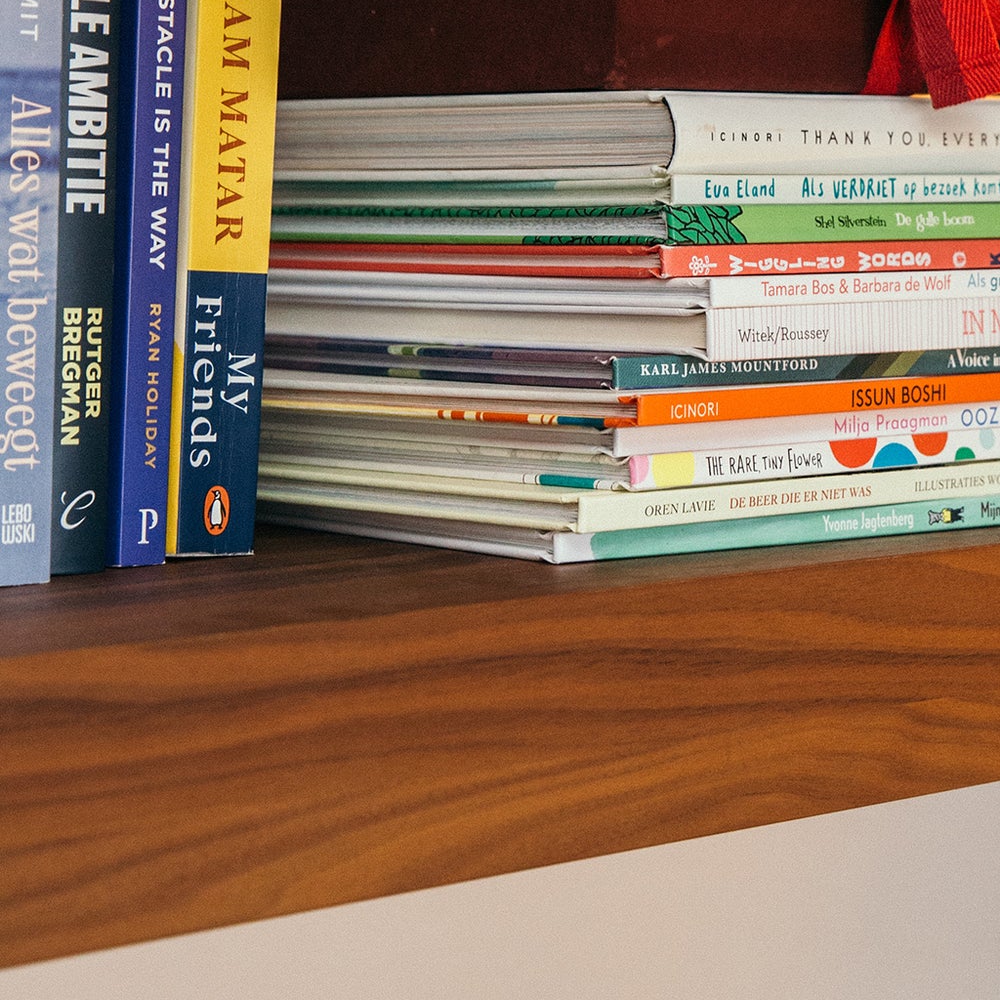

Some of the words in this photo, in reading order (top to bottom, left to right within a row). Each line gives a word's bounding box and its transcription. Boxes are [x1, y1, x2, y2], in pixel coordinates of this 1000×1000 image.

[65, 43, 110, 215] AMBITIE
[153, 107, 171, 133] IS
[710, 131, 782, 143] ICINORI
[800, 129, 872, 146] THANK
[887, 130, 931, 147] YOU.
[9, 93, 53, 194] Alles
[151, 143, 170, 197] THE
[214, 86, 250, 246] MATAR
[704, 179, 730, 199] Eva
[736, 177, 776, 198] Eland
[801, 176, 825, 199] Als
[832, 177, 897, 200] VERDRIET
[904, 181, 917, 200] op
[922, 177, 967, 197] bezoek
[149, 207, 169, 270] WAY
[814, 214, 836, 229] Shel
[837, 214, 887, 228] Silverstein
[895, 211, 912, 227] De
[915, 211, 940, 232] gulle
[942, 211, 975, 227] boom
[7, 205, 43, 284] wat
[728, 254, 846, 276] WIGGLING
[857, 251, 932, 272] WORDS
[760, 280, 808, 297] Tamara
[811, 279, 835, 296] Bos
[838, 278, 849, 295] &
[853, 277, 901, 294] Barbara
[904, 276, 921, 292] de
[923, 275, 952, 291] Wolf
[967, 273, 986, 289] Als
[147, 303, 162, 362] RYAN
[738, 326, 830, 345] Witek/Roussey
[962, 309, 985, 336] IN
[60, 307, 82, 446] BREGMAN
[84, 307, 103, 419] RUTGER
[189, 294, 223, 469] Friends
[219, 351, 257, 415] My
[640, 362, 680, 377] KARL
[681, 361, 727, 378] JAMES
[731, 357, 819, 374] MOUNTFORD
[947, 355, 957, 369] A
[956, 348, 990, 369] Voice
[0, 295, 48, 472] beweegt
[670, 401, 720, 420] ICINORI
[850, 386, 897, 408] ISSUN
[901, 383, 947, 404] BOSHI
[144, 371, 160, 470] HOLIDAY
[833, 416, 871, 437] Milja
[875, 412, 949, 433] Praagman
[960, 406, 1000, 428] OOZ
[706, 455, 725, 477] THE
[2, 503, 33, 524] LEBO
[644, 502, 680, 518] OREN
[681, 499, 717, 515] LAVIE
[729, 496, 747, 511] DE
[748, 494, 779, 509] BEER
[780, 491, 802, 506] DIE
[803, 489, 819, 504] ER
[819, 487, 848, 502] NIET
[849, 485, 873, 499] WAS
[913, 475, 986, 493] ILLUSTRATIES
[1, 523, 35, 545] WSKI
[822, 513, 859, 533] Yvonne
[860, 508, 915, 532] Jagtenberg
